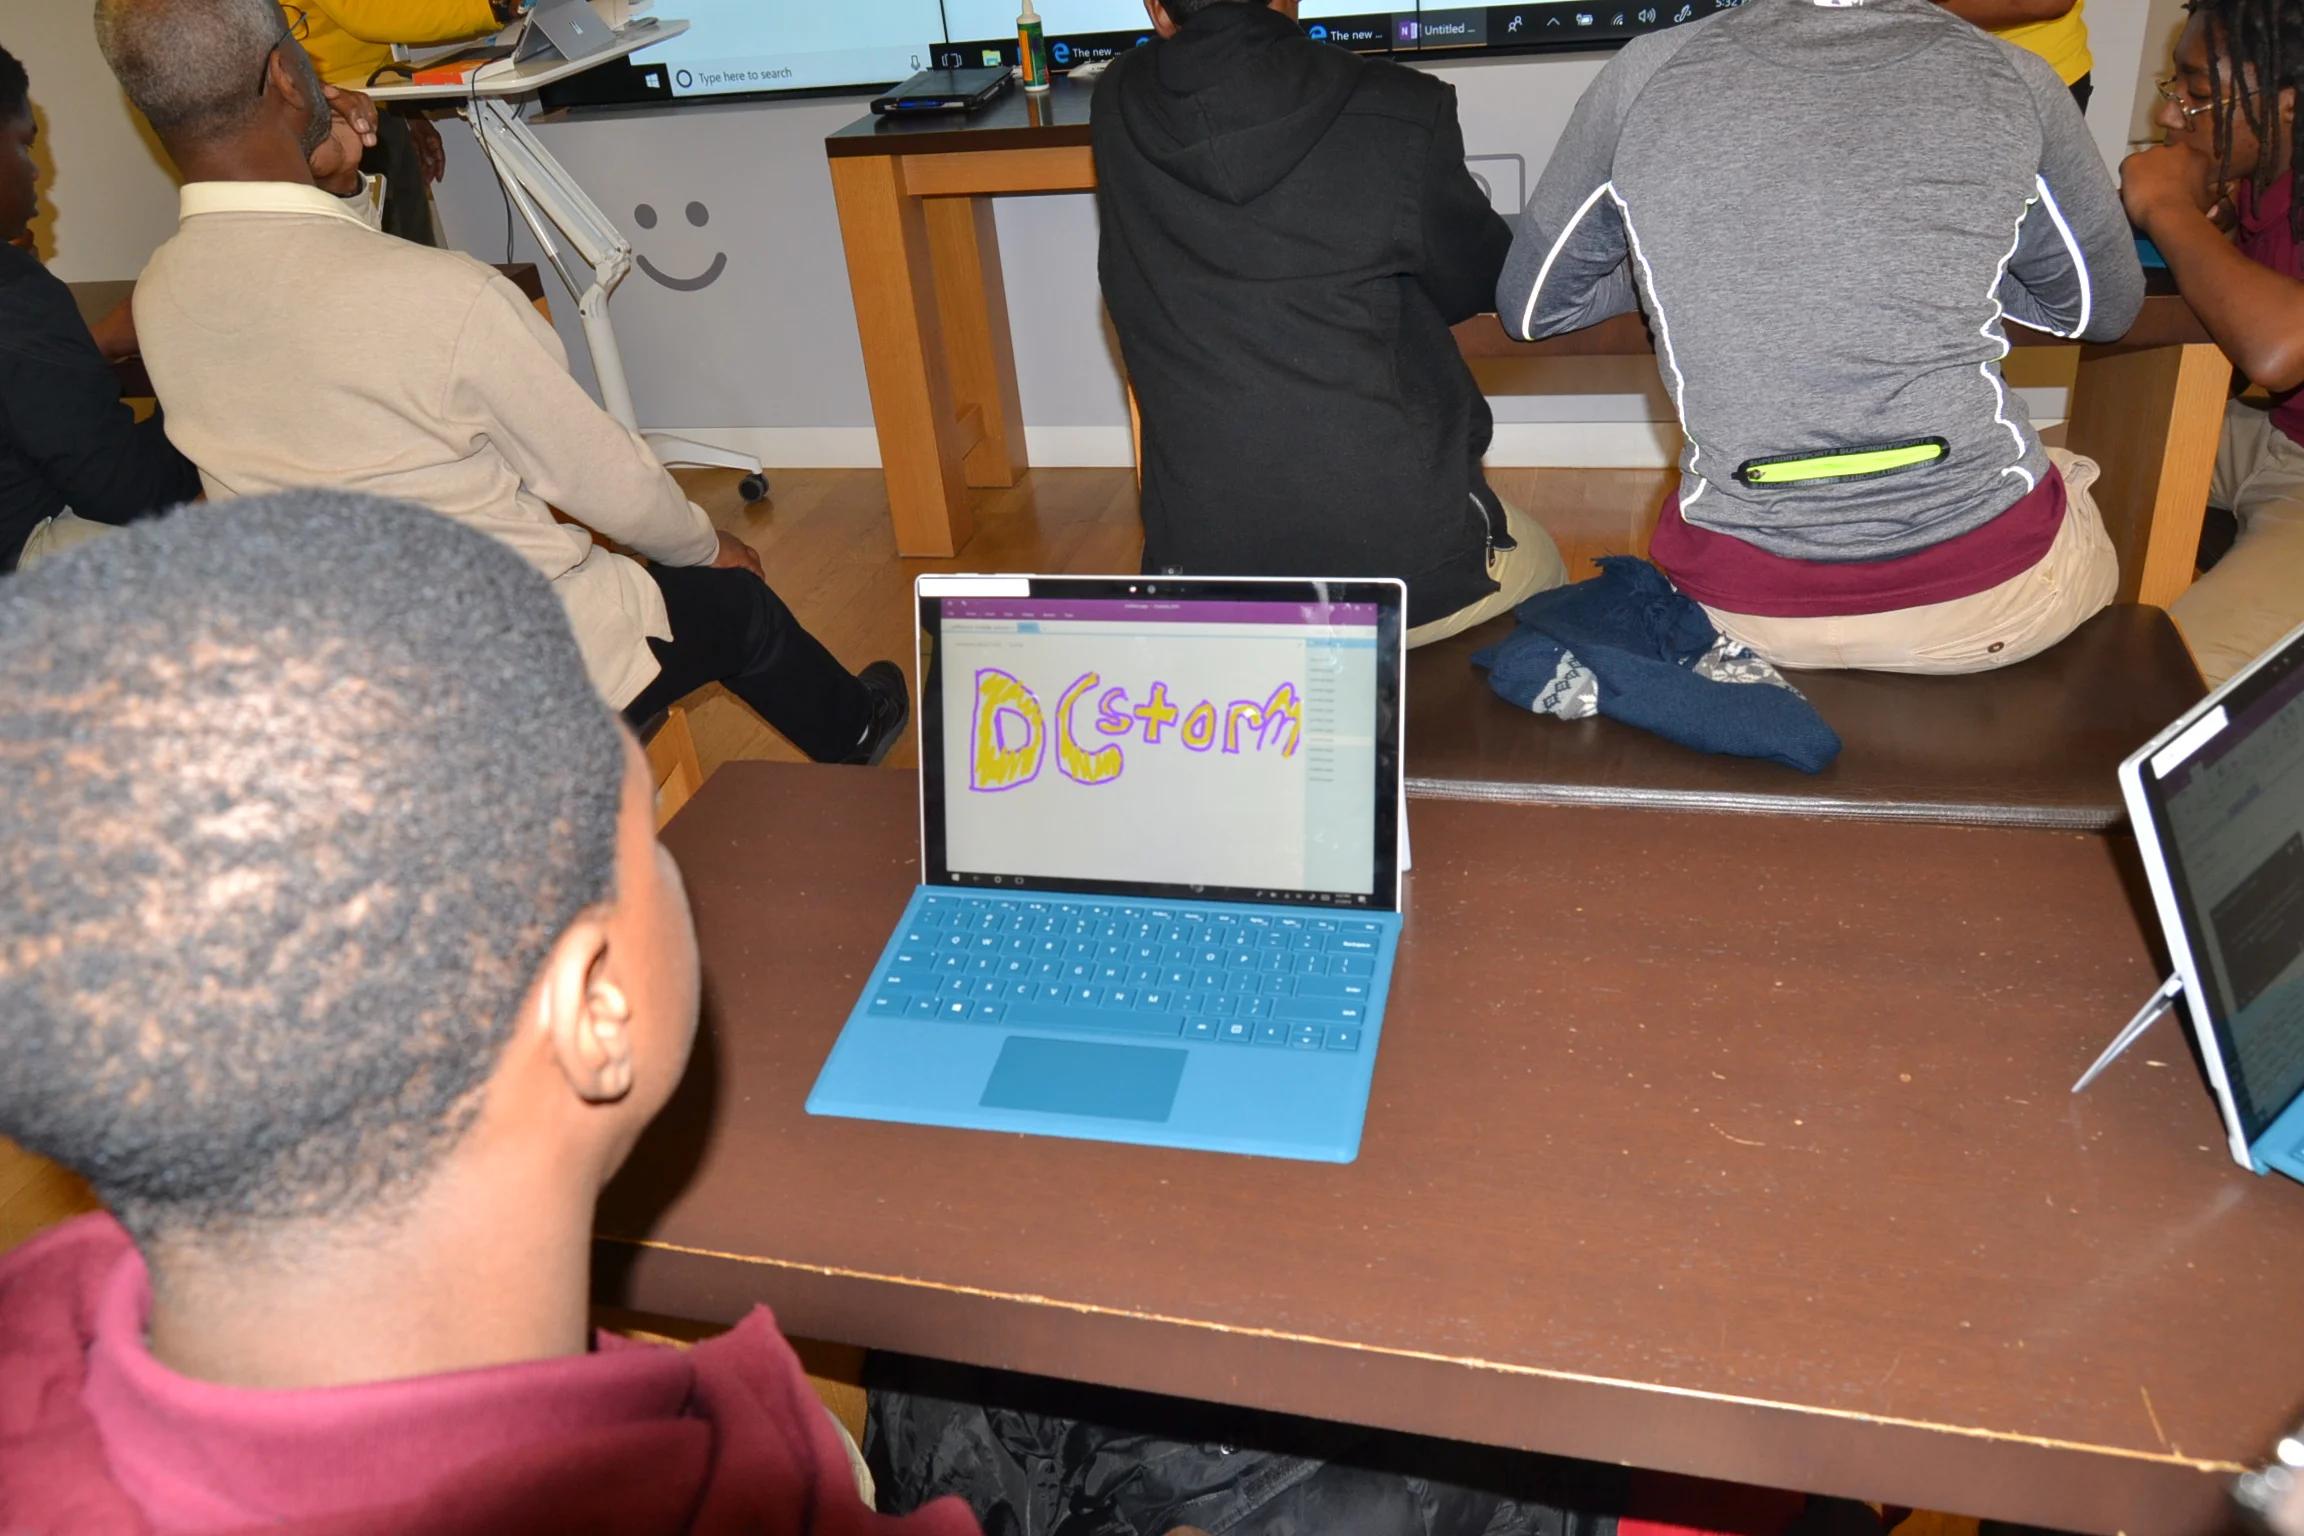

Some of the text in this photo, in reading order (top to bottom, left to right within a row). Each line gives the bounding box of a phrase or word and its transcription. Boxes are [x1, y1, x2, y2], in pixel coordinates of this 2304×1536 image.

[1424, 23, 1465, 35] Untitled
[1330, 30, 1349, 40] The
[1352, 31, 1373, 39] new
[1072, 48, 1090, 57] The
[1092, 48, 1112, 56] new
[698, 67, 792, 86] Type here to search
